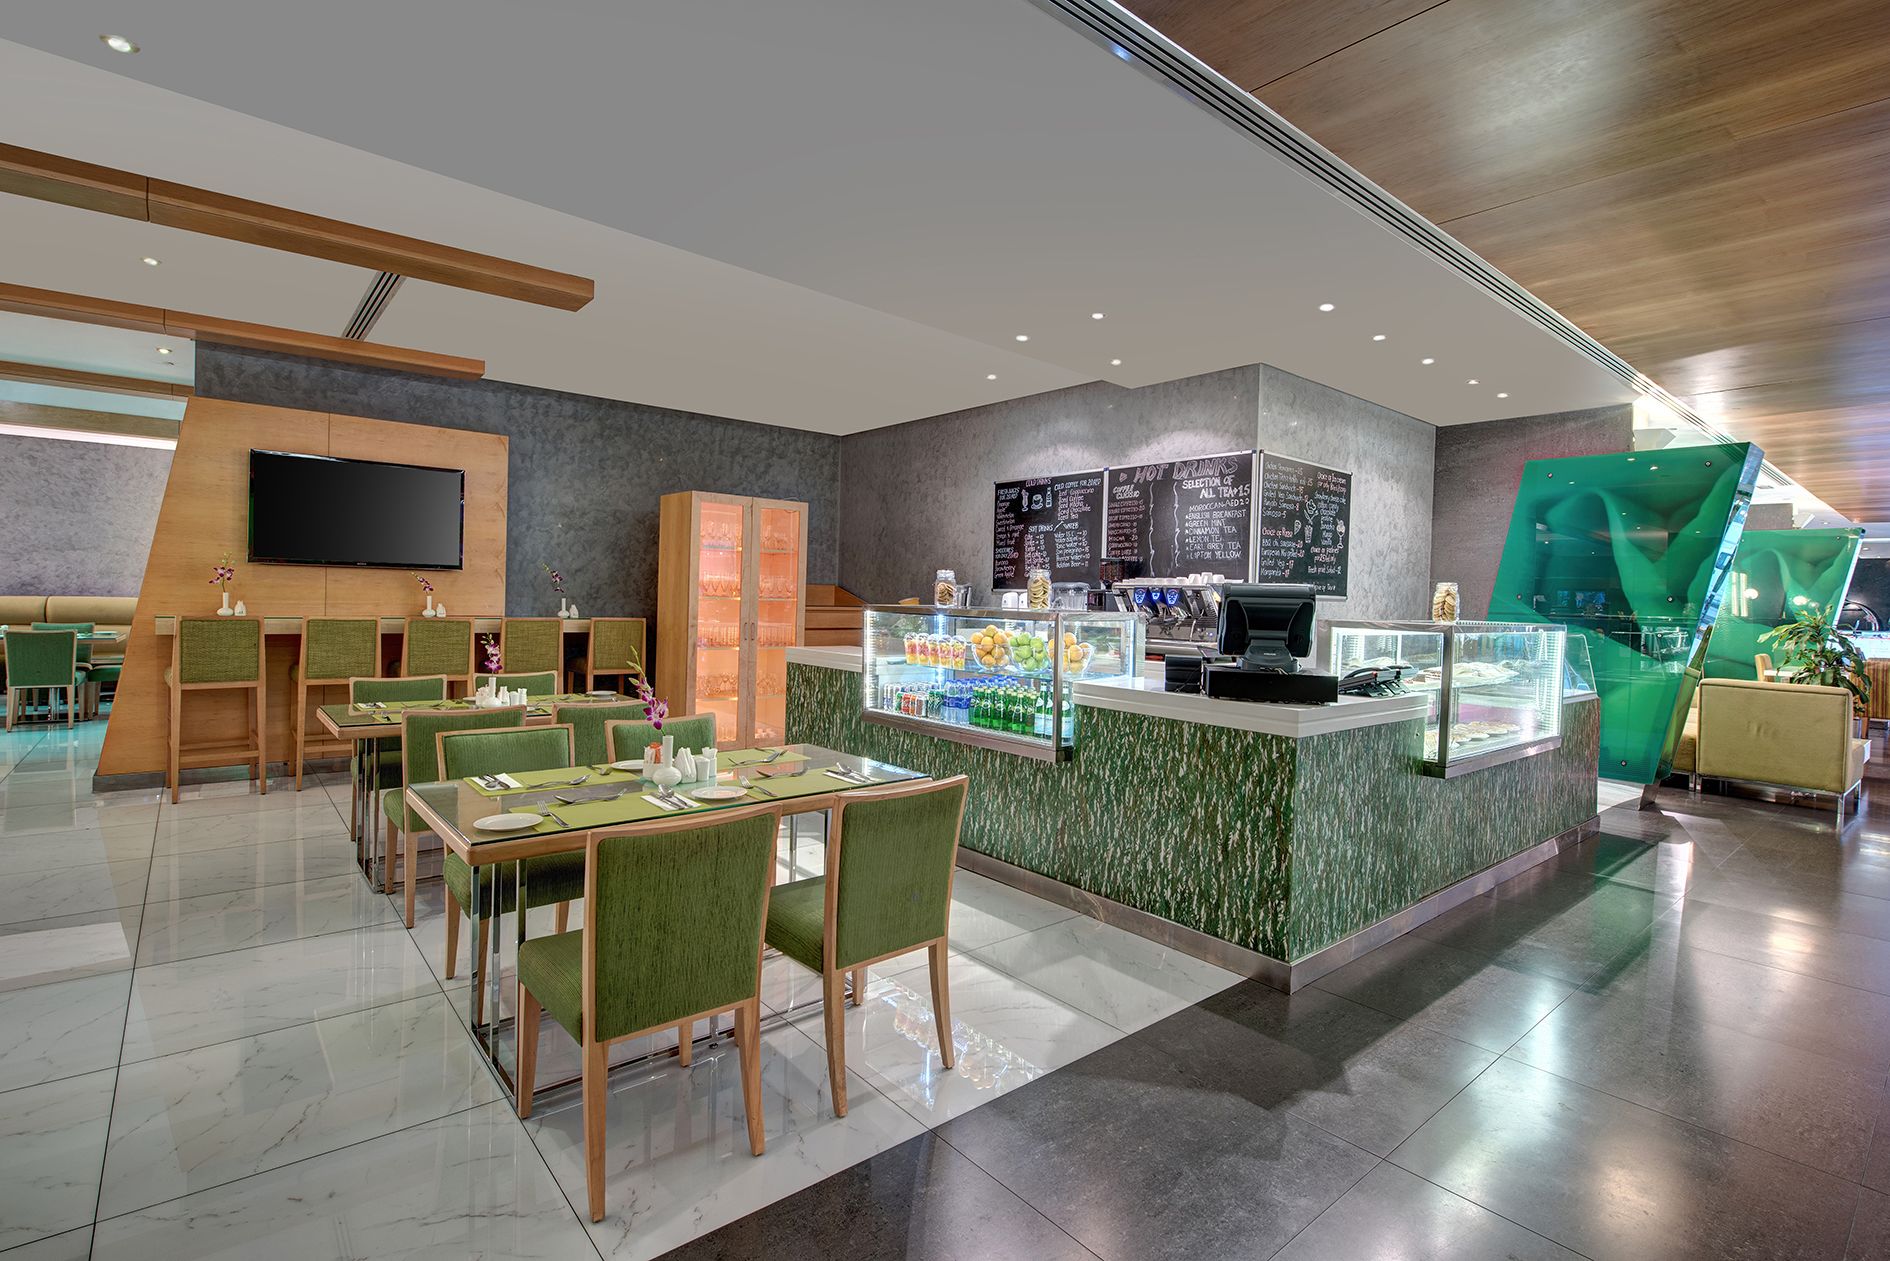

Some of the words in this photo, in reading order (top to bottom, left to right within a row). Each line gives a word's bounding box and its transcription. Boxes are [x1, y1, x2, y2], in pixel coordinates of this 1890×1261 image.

[1134, 464, 1168, 484] HOT
[1172, 456, 1238, 480] DRINKS
[1182, 477, 1221, 489] SELECTION
[1223, 475, 1235, 485] OF
[1054, 483, 1064, 491] COLD
[1113, 484, 1134, 493] COFFEE
[1200, 488, 1216, 498] ALL
[1212, 510, 1246, 519] BREAKFAST
[1188, 527, 1219, 535] CINNAMON
